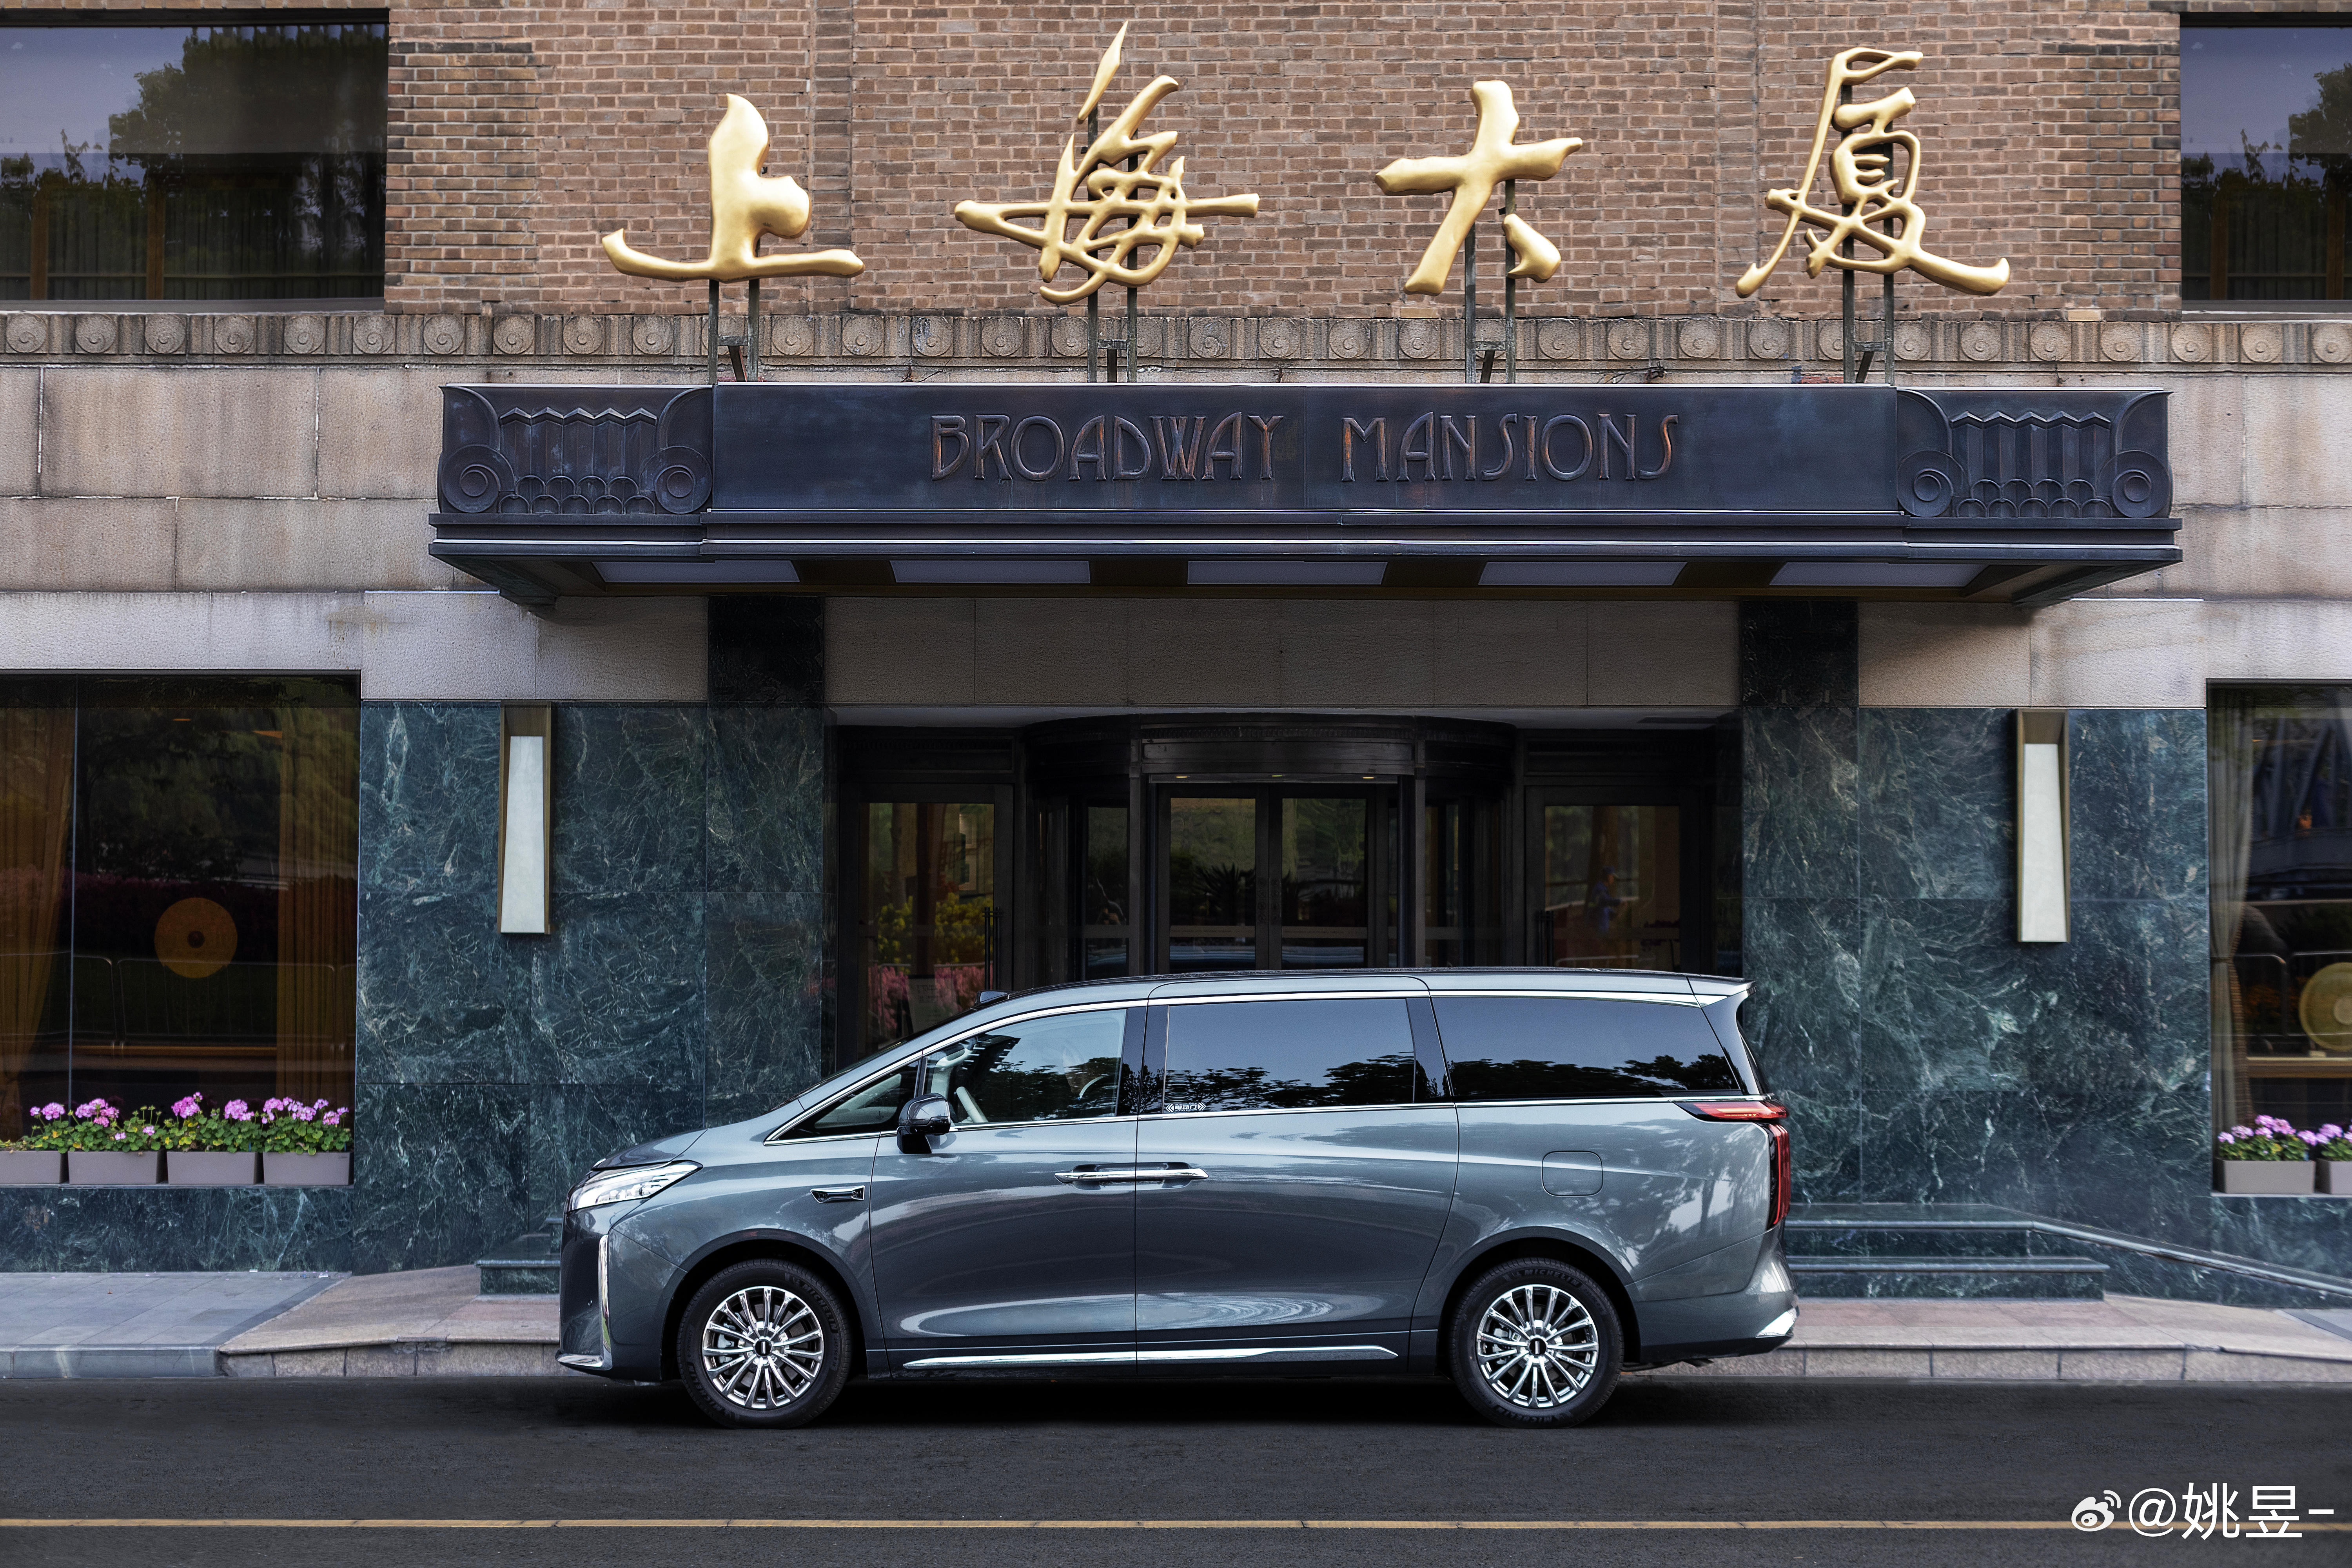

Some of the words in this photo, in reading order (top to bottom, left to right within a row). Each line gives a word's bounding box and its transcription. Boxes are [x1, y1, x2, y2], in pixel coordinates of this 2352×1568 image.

[601, 22, 2010, 305] 上海大厦
[931, 412, 1284, 481] BROADWAY
[1341, 411, 1679, 482] MANSIONS
[1524, 1269, 1580, 1285] MICHELIN
[801, 1283, 838, 1331] MICHELIN
[687, 1364, 723, 1413] MICHELIN
[1496, 1406, 1552, 1423] MICHELIN
